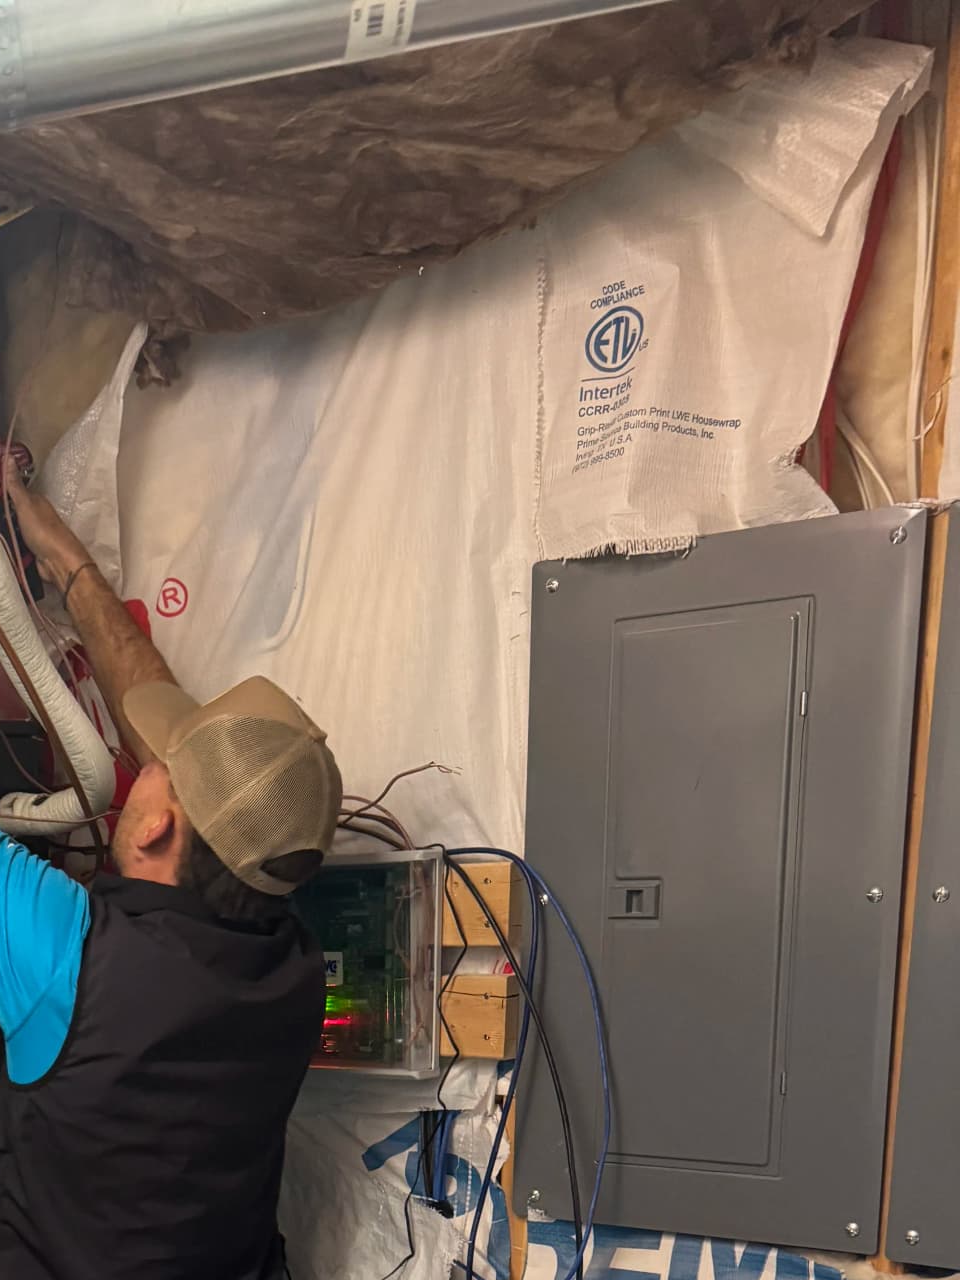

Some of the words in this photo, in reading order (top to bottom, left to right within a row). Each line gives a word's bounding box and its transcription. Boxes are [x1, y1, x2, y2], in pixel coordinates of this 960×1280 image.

[590, 285, 646, 310] COMPLIANCE
[602, 280, 626, 296] CODE
[579, 376, 633, 402] Intertek
[623, 421, 660, 432] Building
[649, 407, 671, 419] Print
[691, 414, 742, 430] Housewrap
